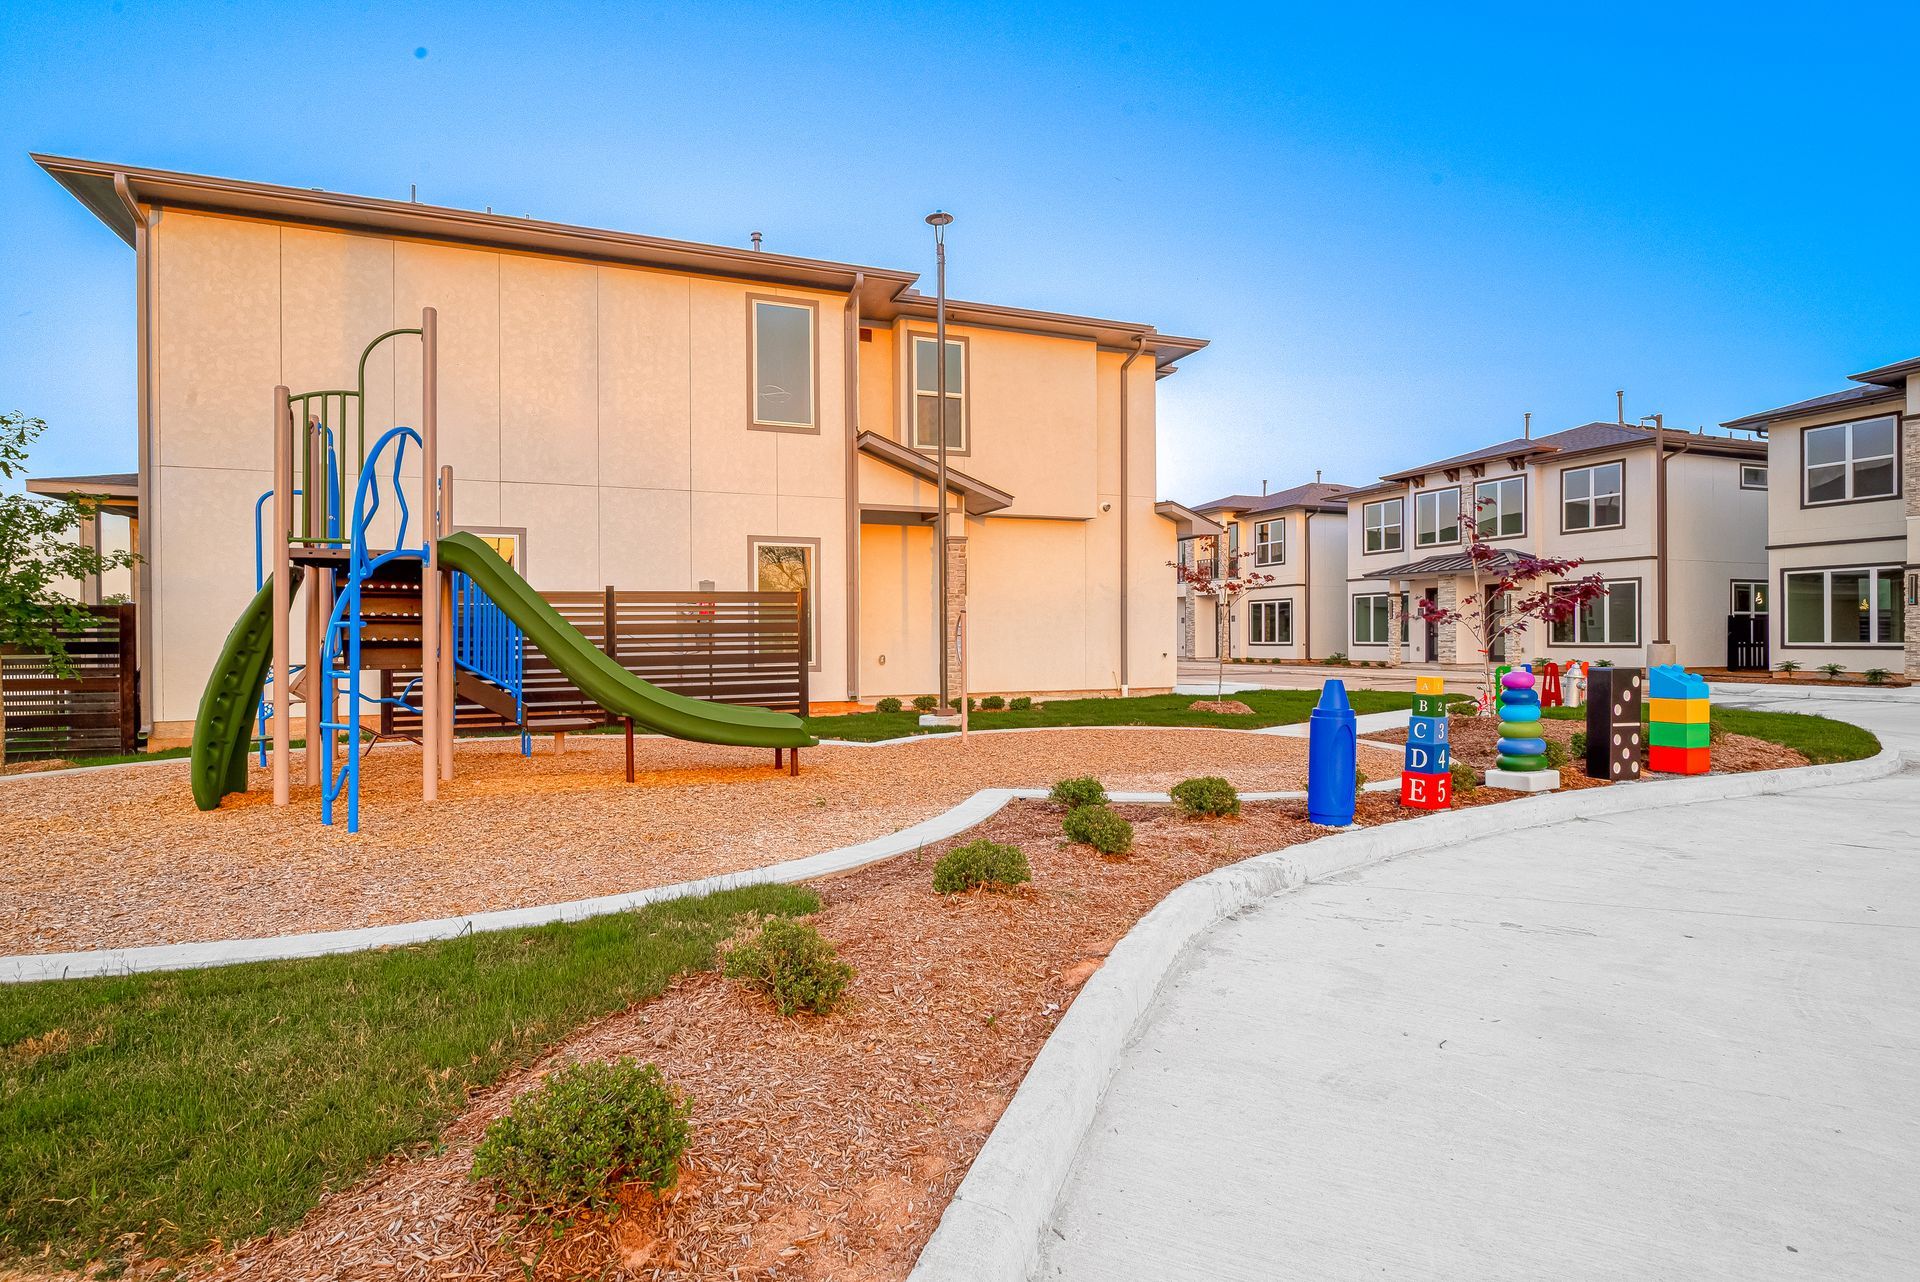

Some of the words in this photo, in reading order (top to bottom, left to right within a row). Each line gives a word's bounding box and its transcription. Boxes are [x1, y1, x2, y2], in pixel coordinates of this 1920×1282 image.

[1419, 699, 1428, 712] B
[1438, 702, 1443, 712] 2
[1414, 722, 1427, 739] C
[1438, 723, 1445, 739] 3
[1411, 748, 1428, 768] D
[1438, 749, 1446, 769] 4
[1408, 778, 1426, 803] E
[1438, 779, 1446, 803] 5
